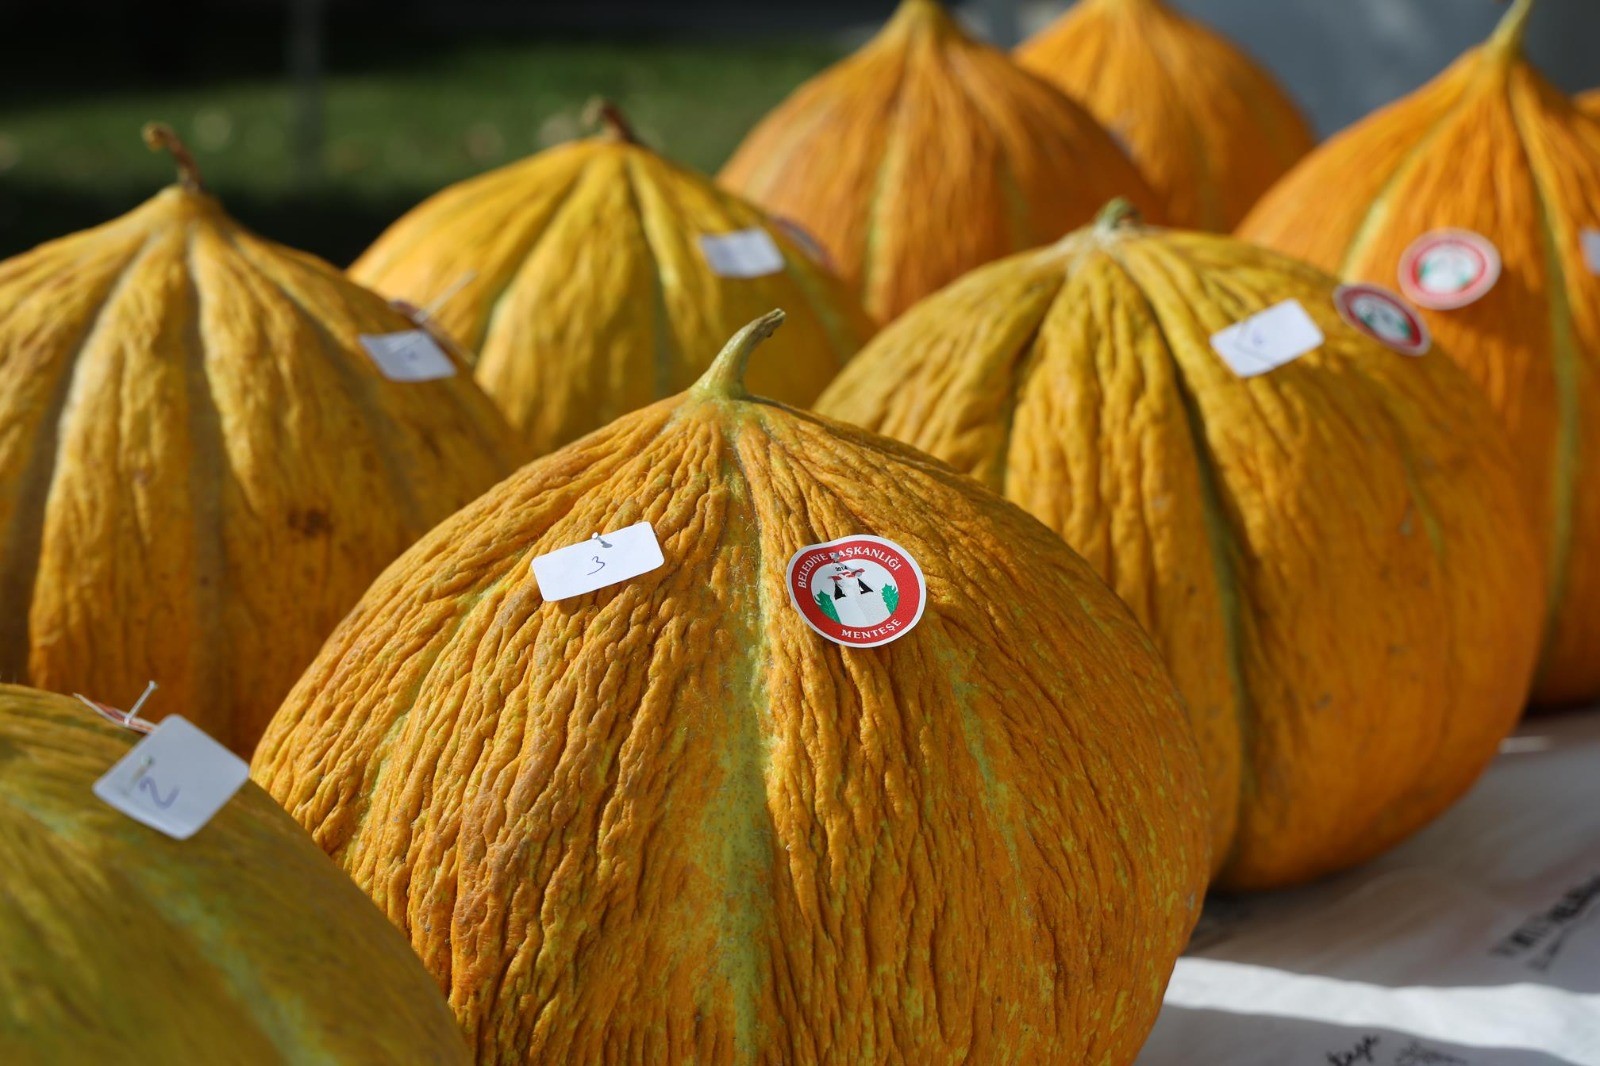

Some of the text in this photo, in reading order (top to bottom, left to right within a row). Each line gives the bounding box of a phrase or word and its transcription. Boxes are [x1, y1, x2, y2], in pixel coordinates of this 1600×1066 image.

[587, 556, 606, 576] 3
[798, 552, 828, 588] BELEDİYE
[841, 618, 902, 639] MENTEŞE
[139, 776, 180, 809] 2
